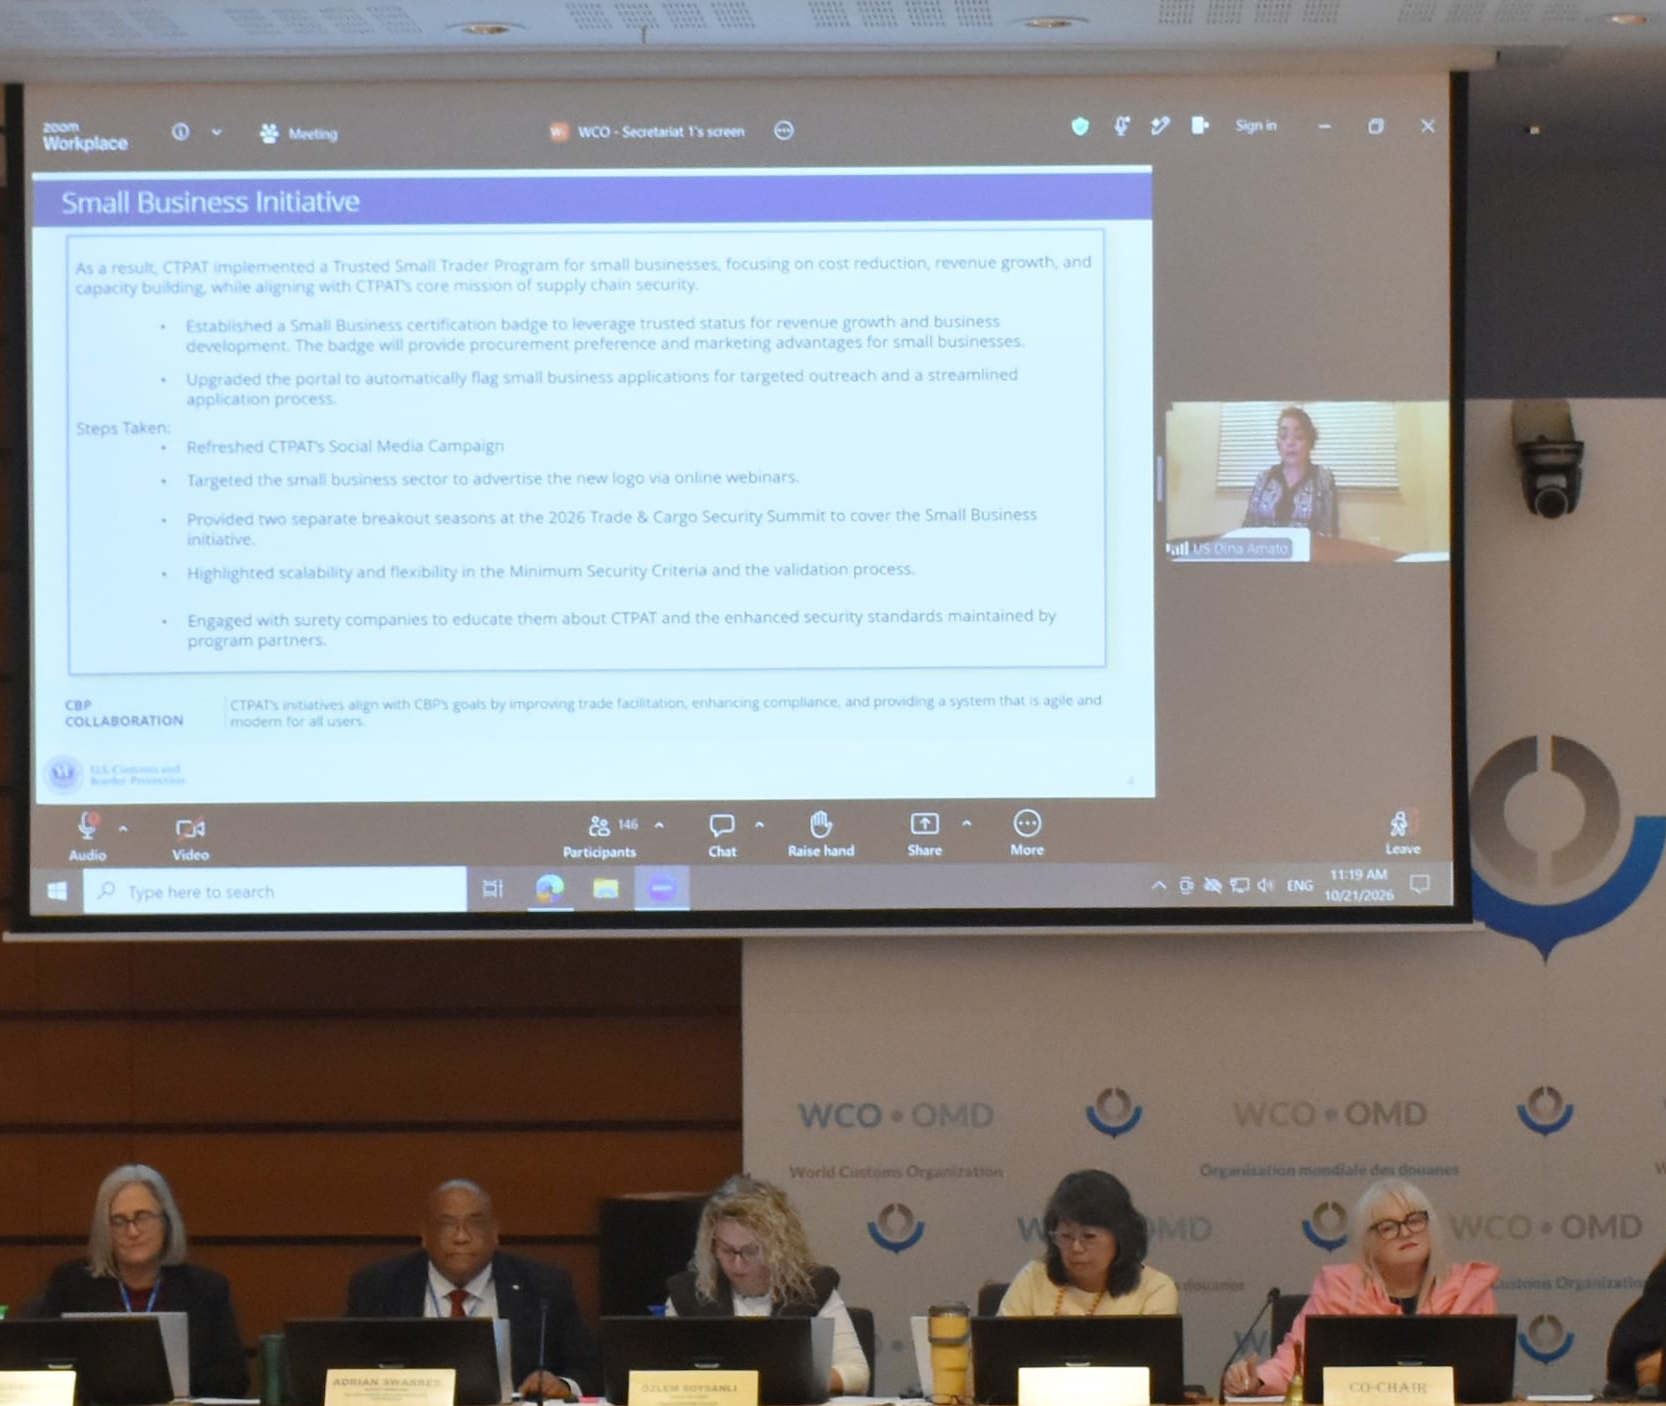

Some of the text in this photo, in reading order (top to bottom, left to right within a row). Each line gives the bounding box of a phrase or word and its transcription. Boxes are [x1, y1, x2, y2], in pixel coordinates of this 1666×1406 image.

[42, 122, 79, 133] zoom
[577, 126, 611, 138] WCO
[621, 125, 684, 138] Secretariat
[687, 125, 704, 137] 1's
[706, 128, 745, 137] screen
[1235, 118, 1277, 135] Sign in
[288, 127, 338, 144] Meeting
[42, 135, 128, 153] Workplace
[61, 190, 360, 214] Small Business Initiative
[74, 255, 1092, 277] As a result, CTPAT implemented a Trusted Small Trader Program for small businesses, focusing on cost reduction, revenue growth, and
[76, 421, 170, 438] Steps Taken:
[186, 439, 504, 456] Refreshed CTPAT's Social Media Campaign
[64, 699, 92, 712] CBP
[64, 715, 183, 728] COLLABORATION
[618, 819, 639, 830] 146
[68, 849, 107, 861] Audio
[171, 849, 210, 861] Video
[562, 846, 637, 860] Participants
[708, 845, 737, 858] Chat
[787, 844, 855, 857] Raise hand
[907, 844, 943, 856] Share
[1010, 843, 1045, 856] More
[1385, 843, 1421, 855] Leave
[1366, 869, 1388, 880] AM
[1286, 879, 1313, 892] ENG
[127, 885, 274, 902] Type here to search
[799, 1103, 994, 1128] WCO OMD
[1235, 1101, 1427, 1127] WCO OMD
[789, 1165, 1003, 1180] World Customs Organization
[1200, 1164, 1459, 1178] Organisation mondiale des douanes
[1451, 1214, 1643, 1240] WCO OMD
[1349, 1382, 1428, 1393] CO-CHAIR
